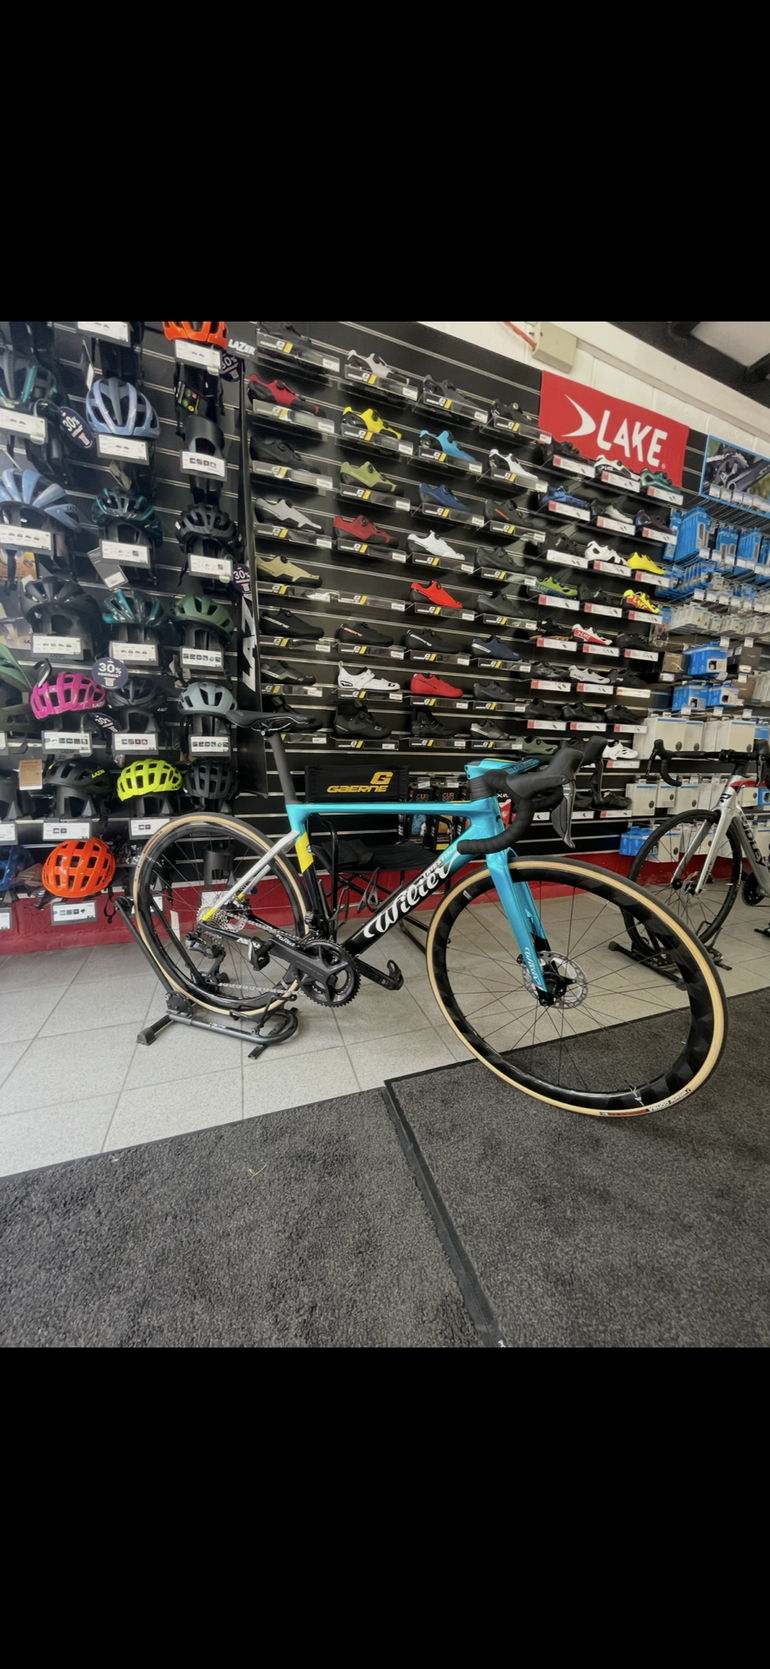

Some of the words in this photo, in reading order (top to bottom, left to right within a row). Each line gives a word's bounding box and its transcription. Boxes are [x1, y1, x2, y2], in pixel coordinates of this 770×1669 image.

[228, 339, 256, 355] LAZER
[597, 410, 668, 467] LAKE
[98, 662, 121, 674] 30%
[326, 785, 389, 793] GAERNE
[363, 851, 460, 938] Wilier
